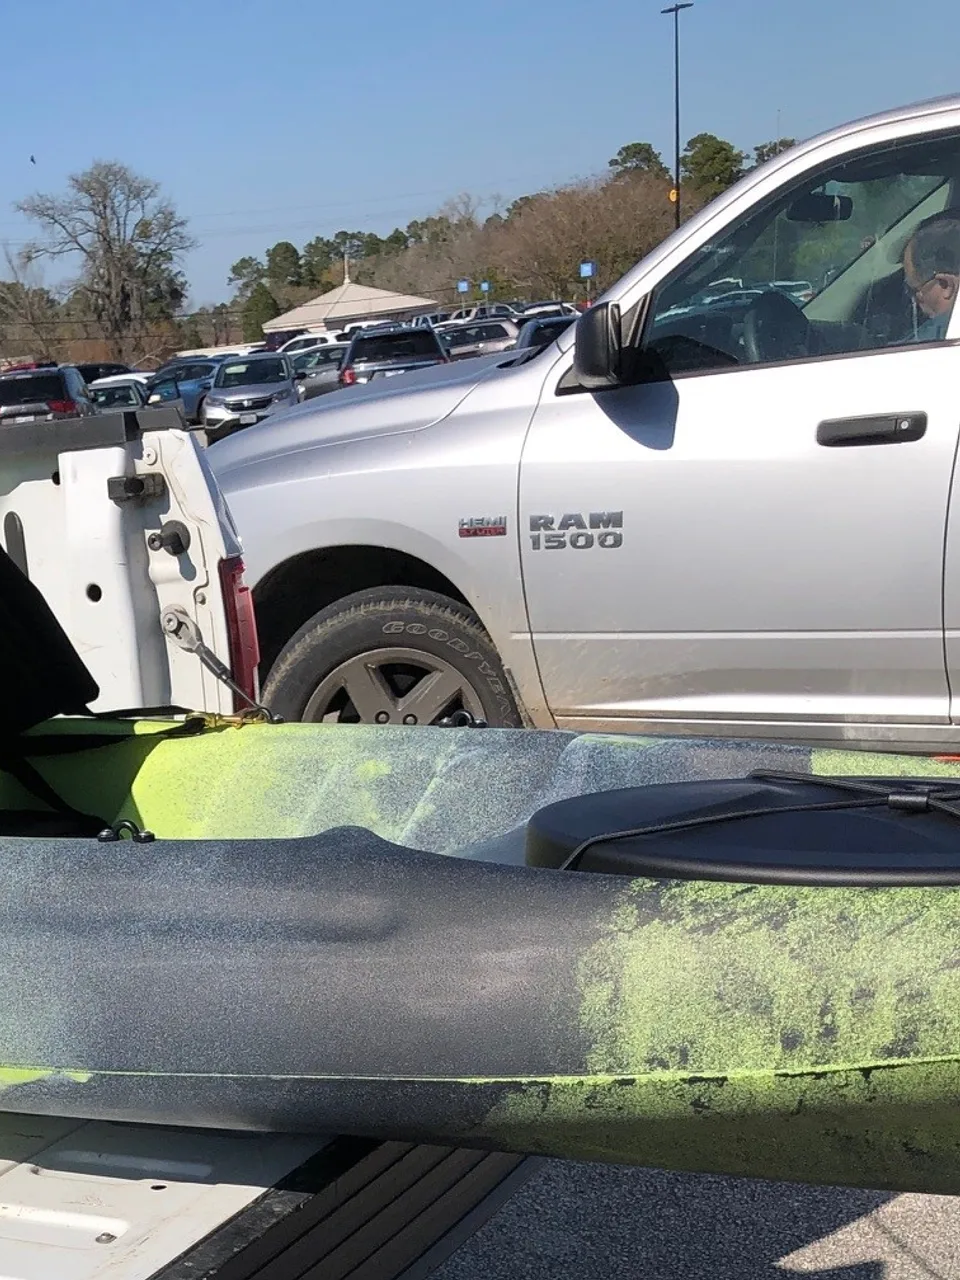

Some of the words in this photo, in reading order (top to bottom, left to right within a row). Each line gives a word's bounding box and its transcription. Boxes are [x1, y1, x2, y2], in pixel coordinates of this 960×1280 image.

[458, 515, 507, 527] HEMI
[529, 511, 623, 532] RAM
[529, 531, 623, 550] 1500
